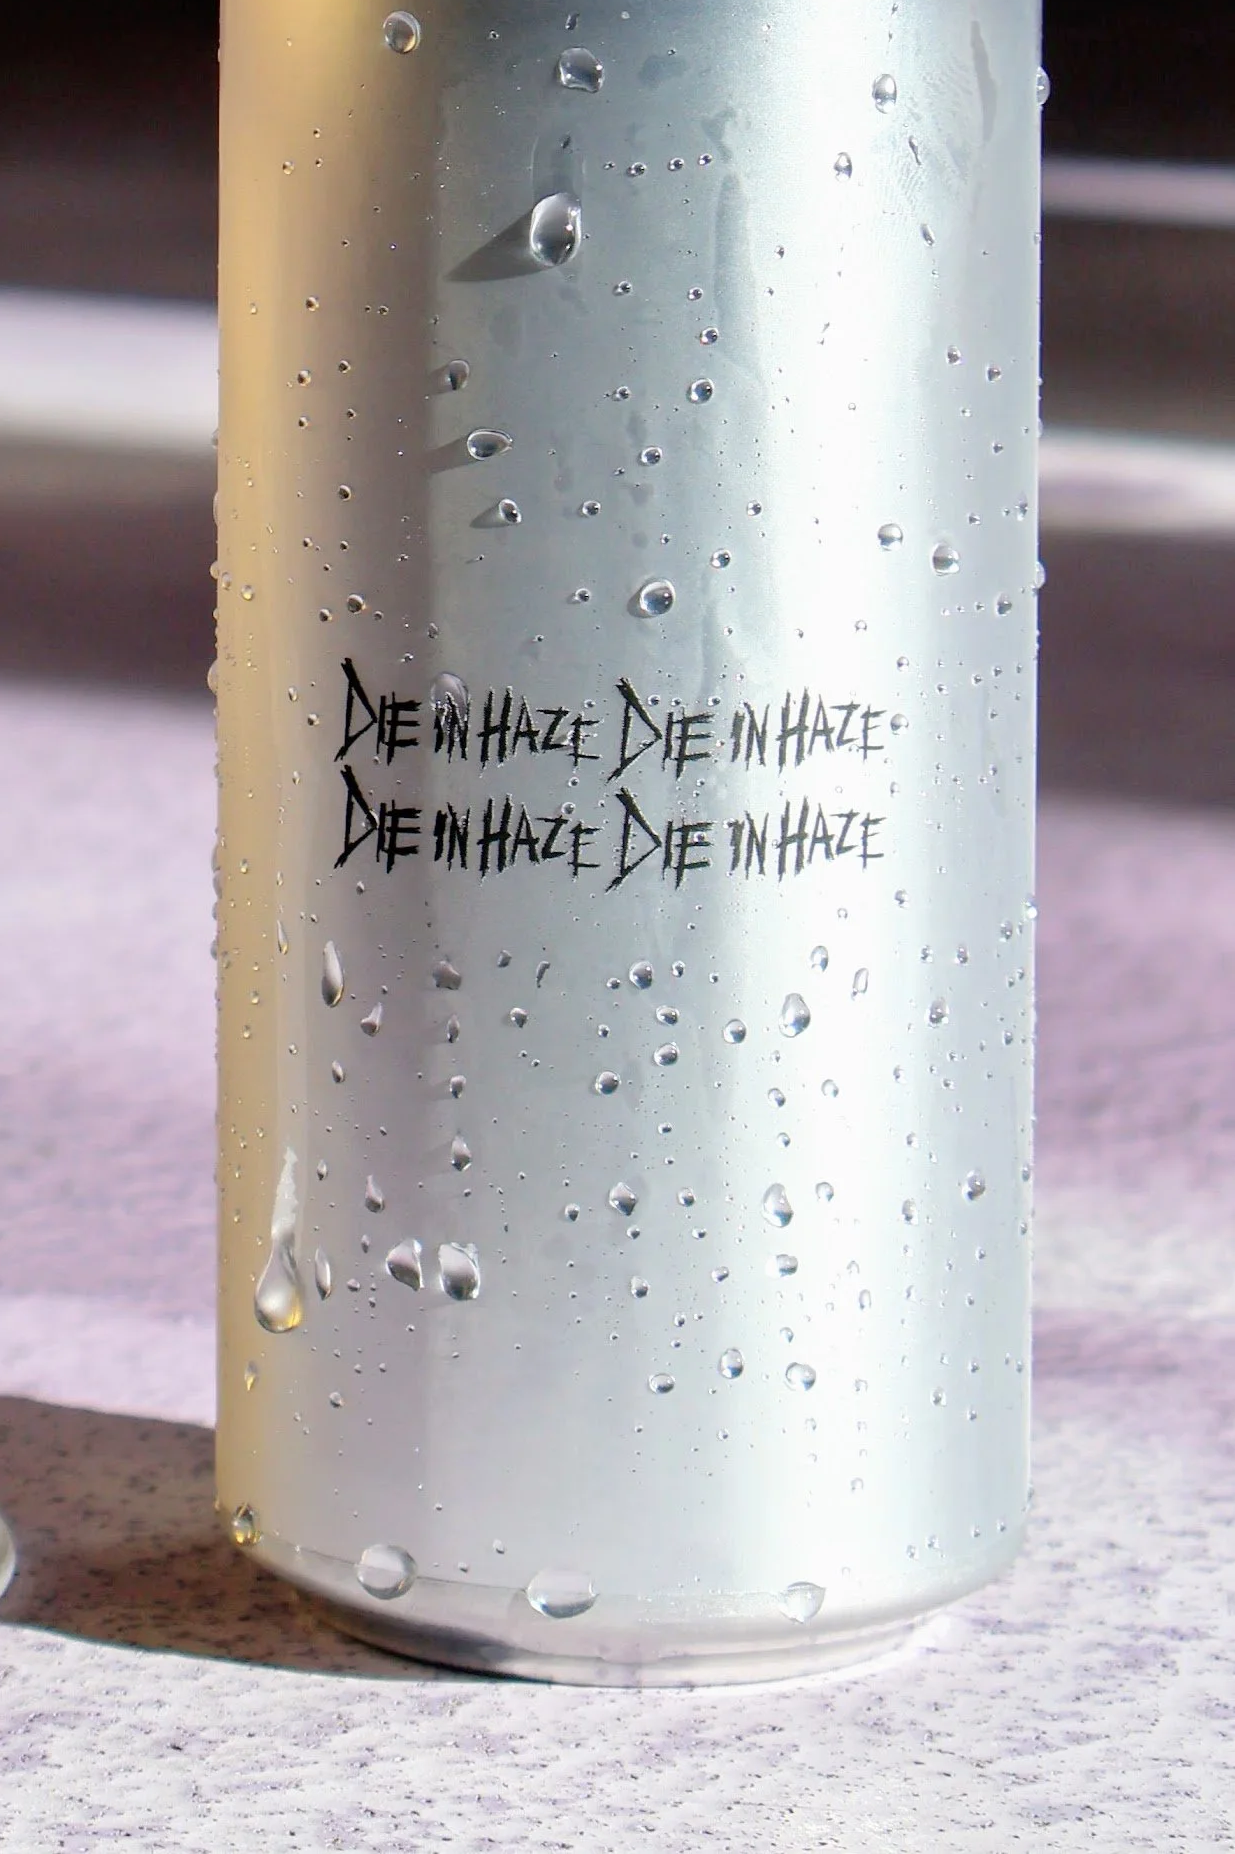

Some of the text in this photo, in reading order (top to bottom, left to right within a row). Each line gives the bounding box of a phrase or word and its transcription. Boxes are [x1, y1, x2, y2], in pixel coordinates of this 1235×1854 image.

[333, 657, 888, 784] DIE IN HAZE DIE IN HAZE
[333, 764, 887, 893] DIE IN HAZE DIE IN HAZE
